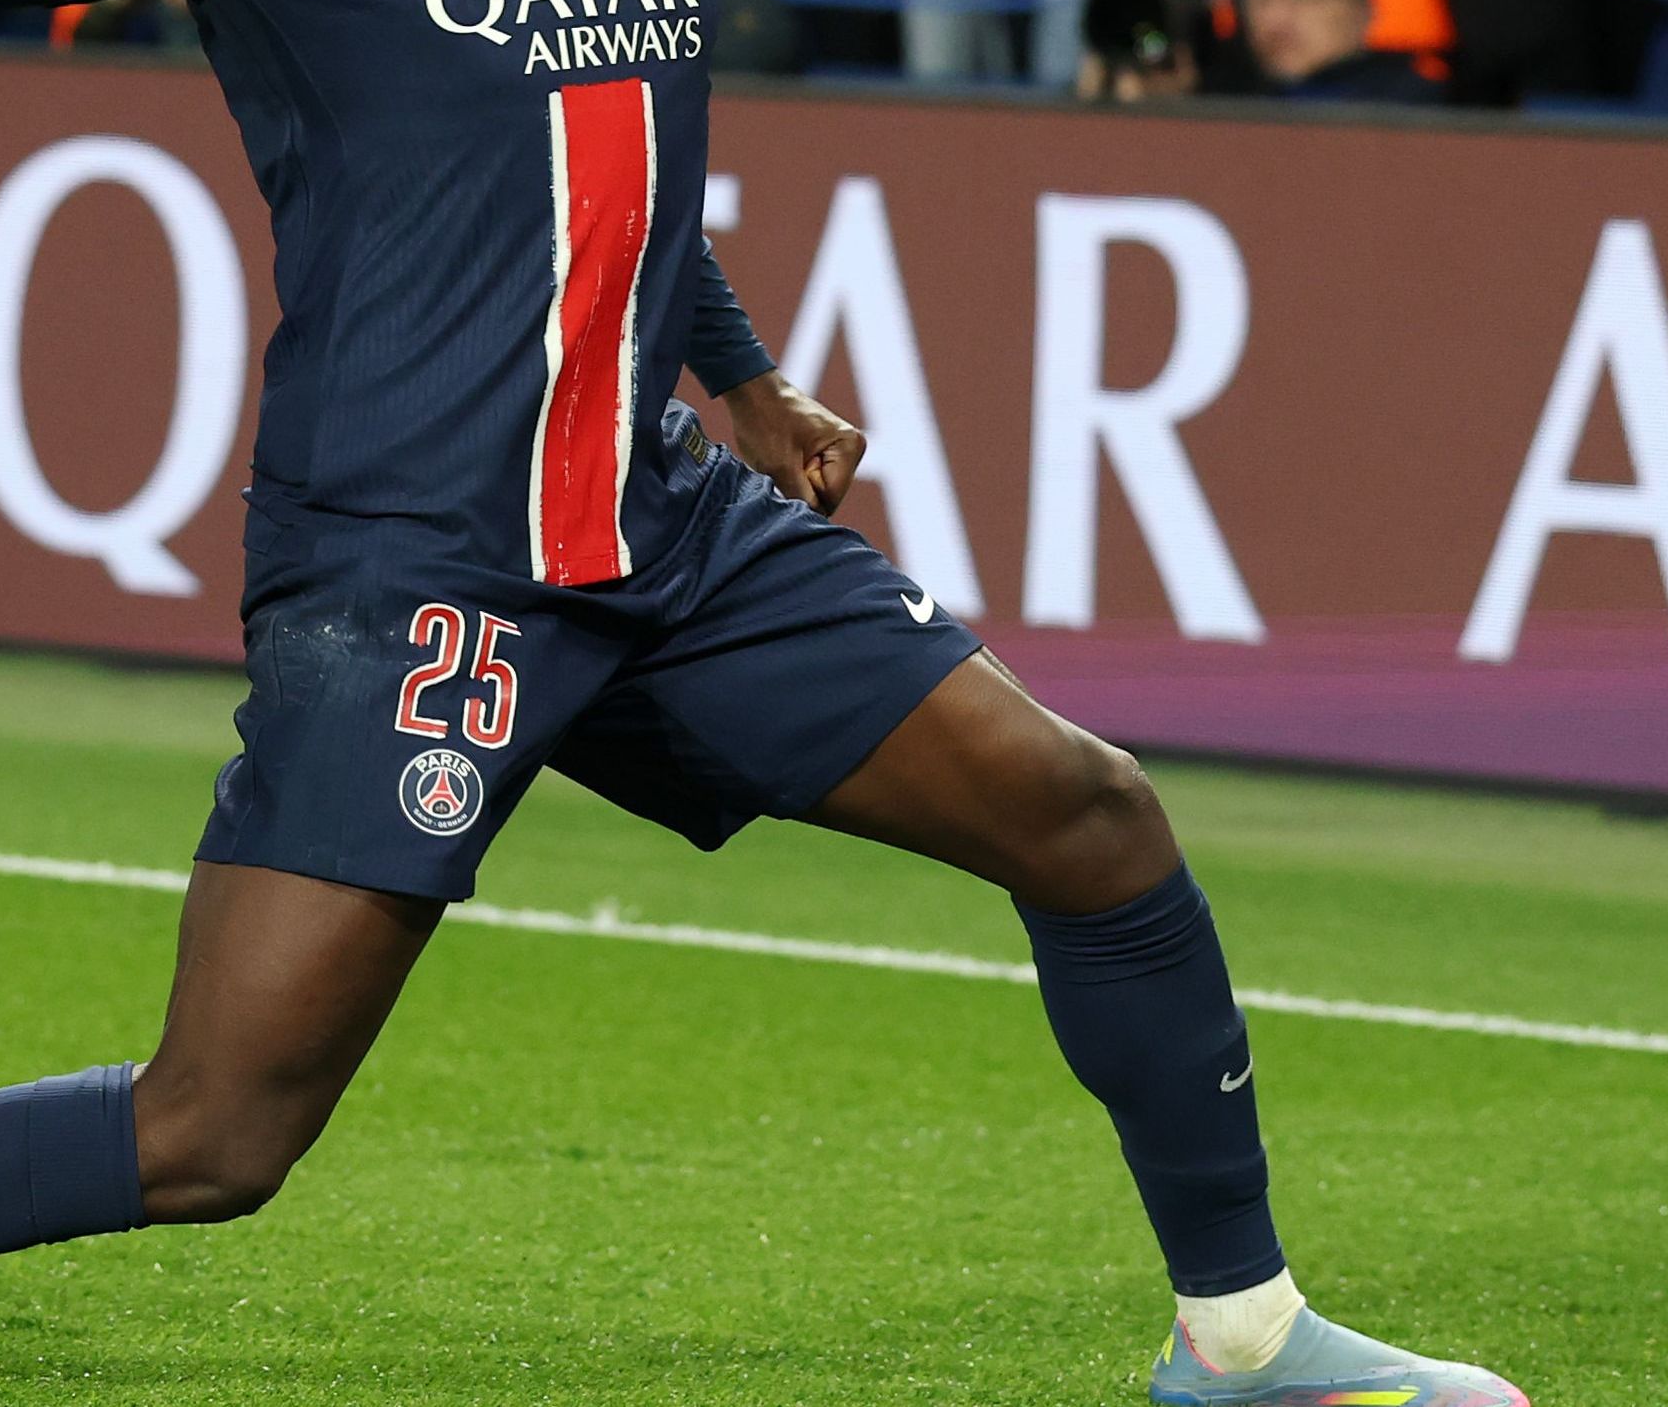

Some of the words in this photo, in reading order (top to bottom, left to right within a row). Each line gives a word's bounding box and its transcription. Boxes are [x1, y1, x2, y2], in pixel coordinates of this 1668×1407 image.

[523, 16, 703, 75] AIRWAYS
[394, 602, 523, 750] 25
[414, 753, 472, 779] PARIS
